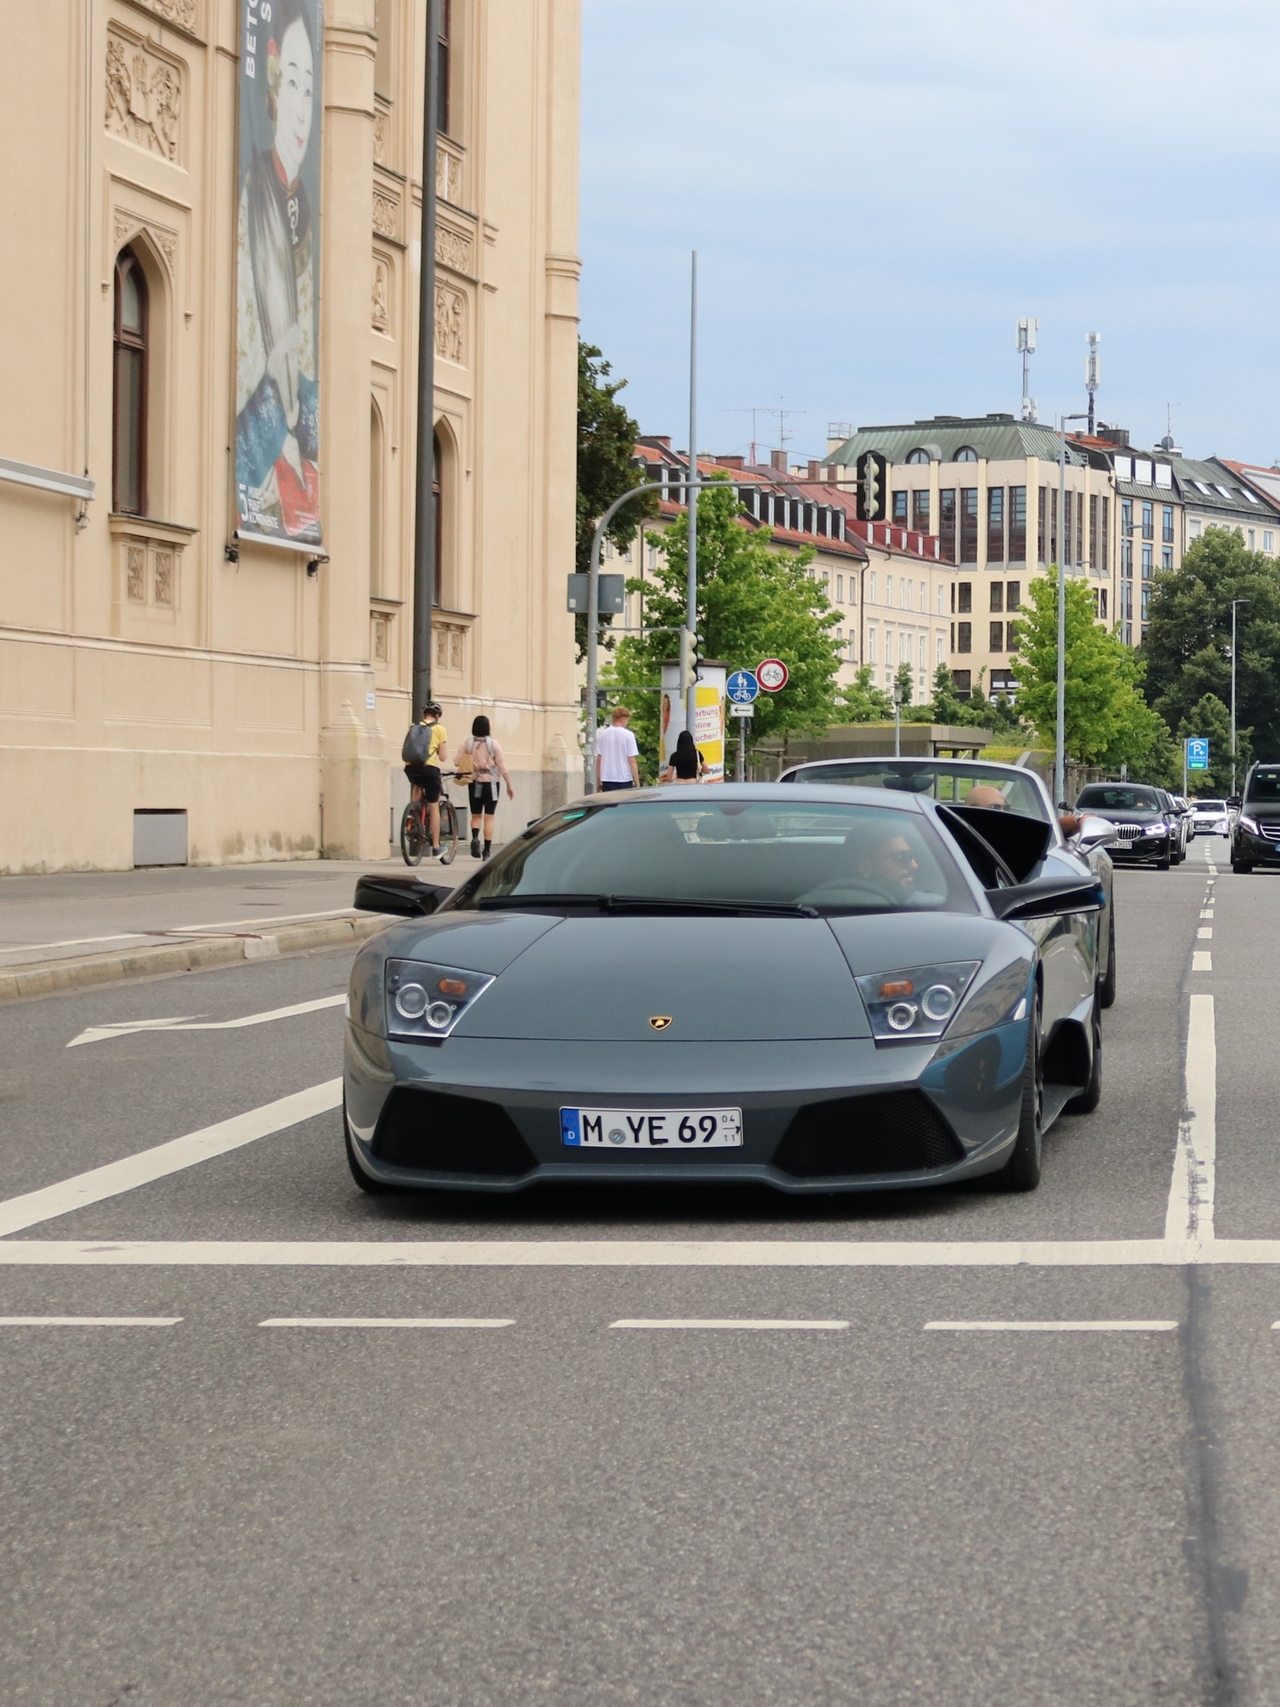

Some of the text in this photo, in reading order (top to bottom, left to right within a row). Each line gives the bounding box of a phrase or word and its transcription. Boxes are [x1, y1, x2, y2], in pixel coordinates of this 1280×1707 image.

[695, 709, 718, 718] erbung
[722, 1115, 735, 1123] 04
[567, 1115, 718, 1146] D M YE 69
[724, 1134, 735, 1142] 11
